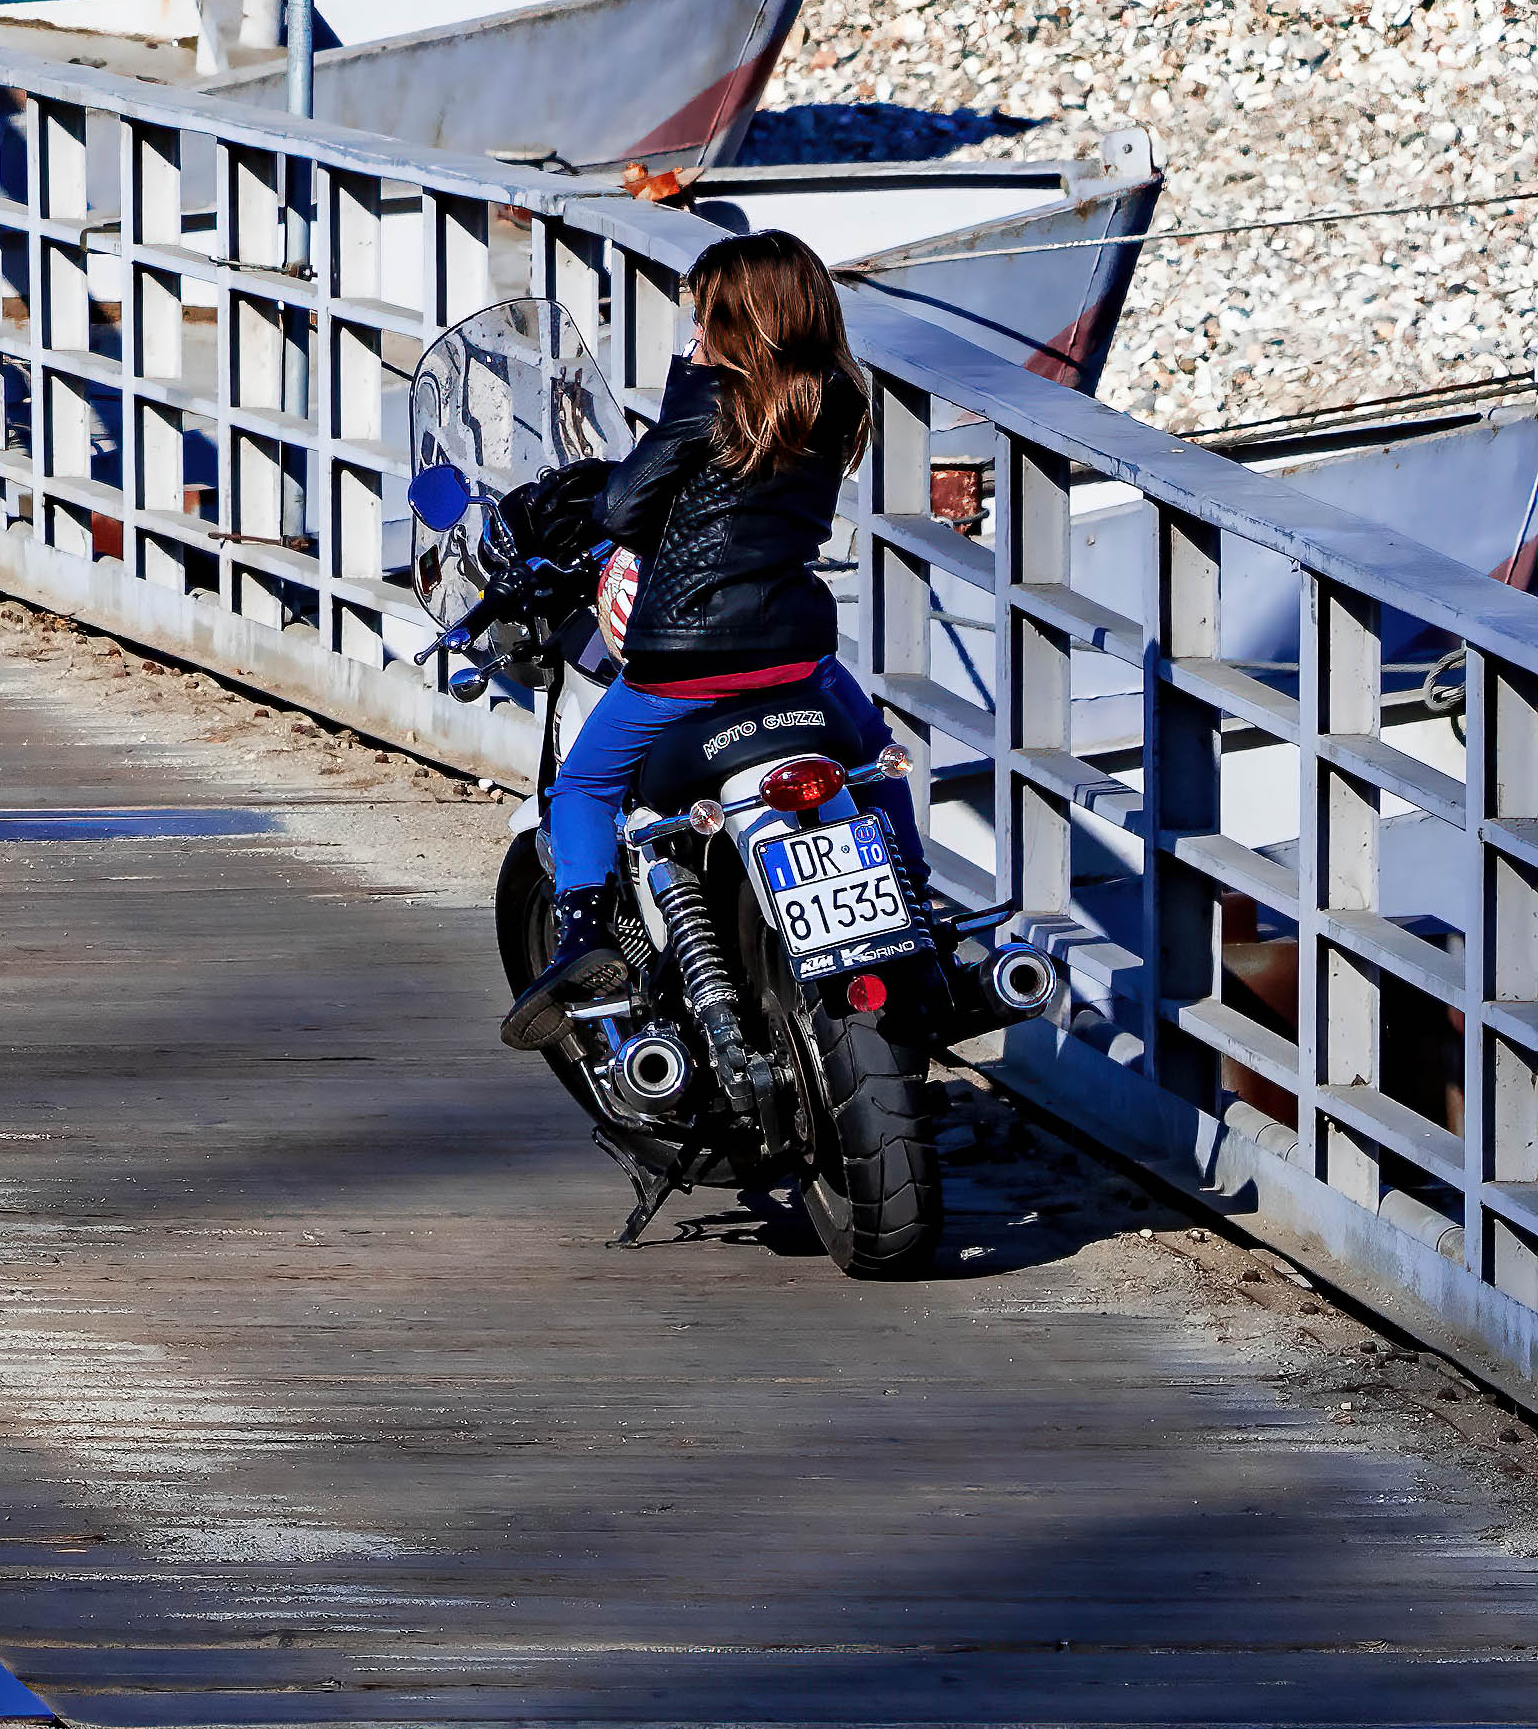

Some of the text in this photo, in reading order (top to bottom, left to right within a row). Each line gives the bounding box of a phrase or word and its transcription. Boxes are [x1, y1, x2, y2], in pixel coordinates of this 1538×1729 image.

[703, 710, 826, 760] MOTO GUZZI
[790, 836, 841, 882] DR
[859, 843, 883, 865] TO
[785, 875, 899, 940] 81535
[799, 954, 834, 974] KTM
